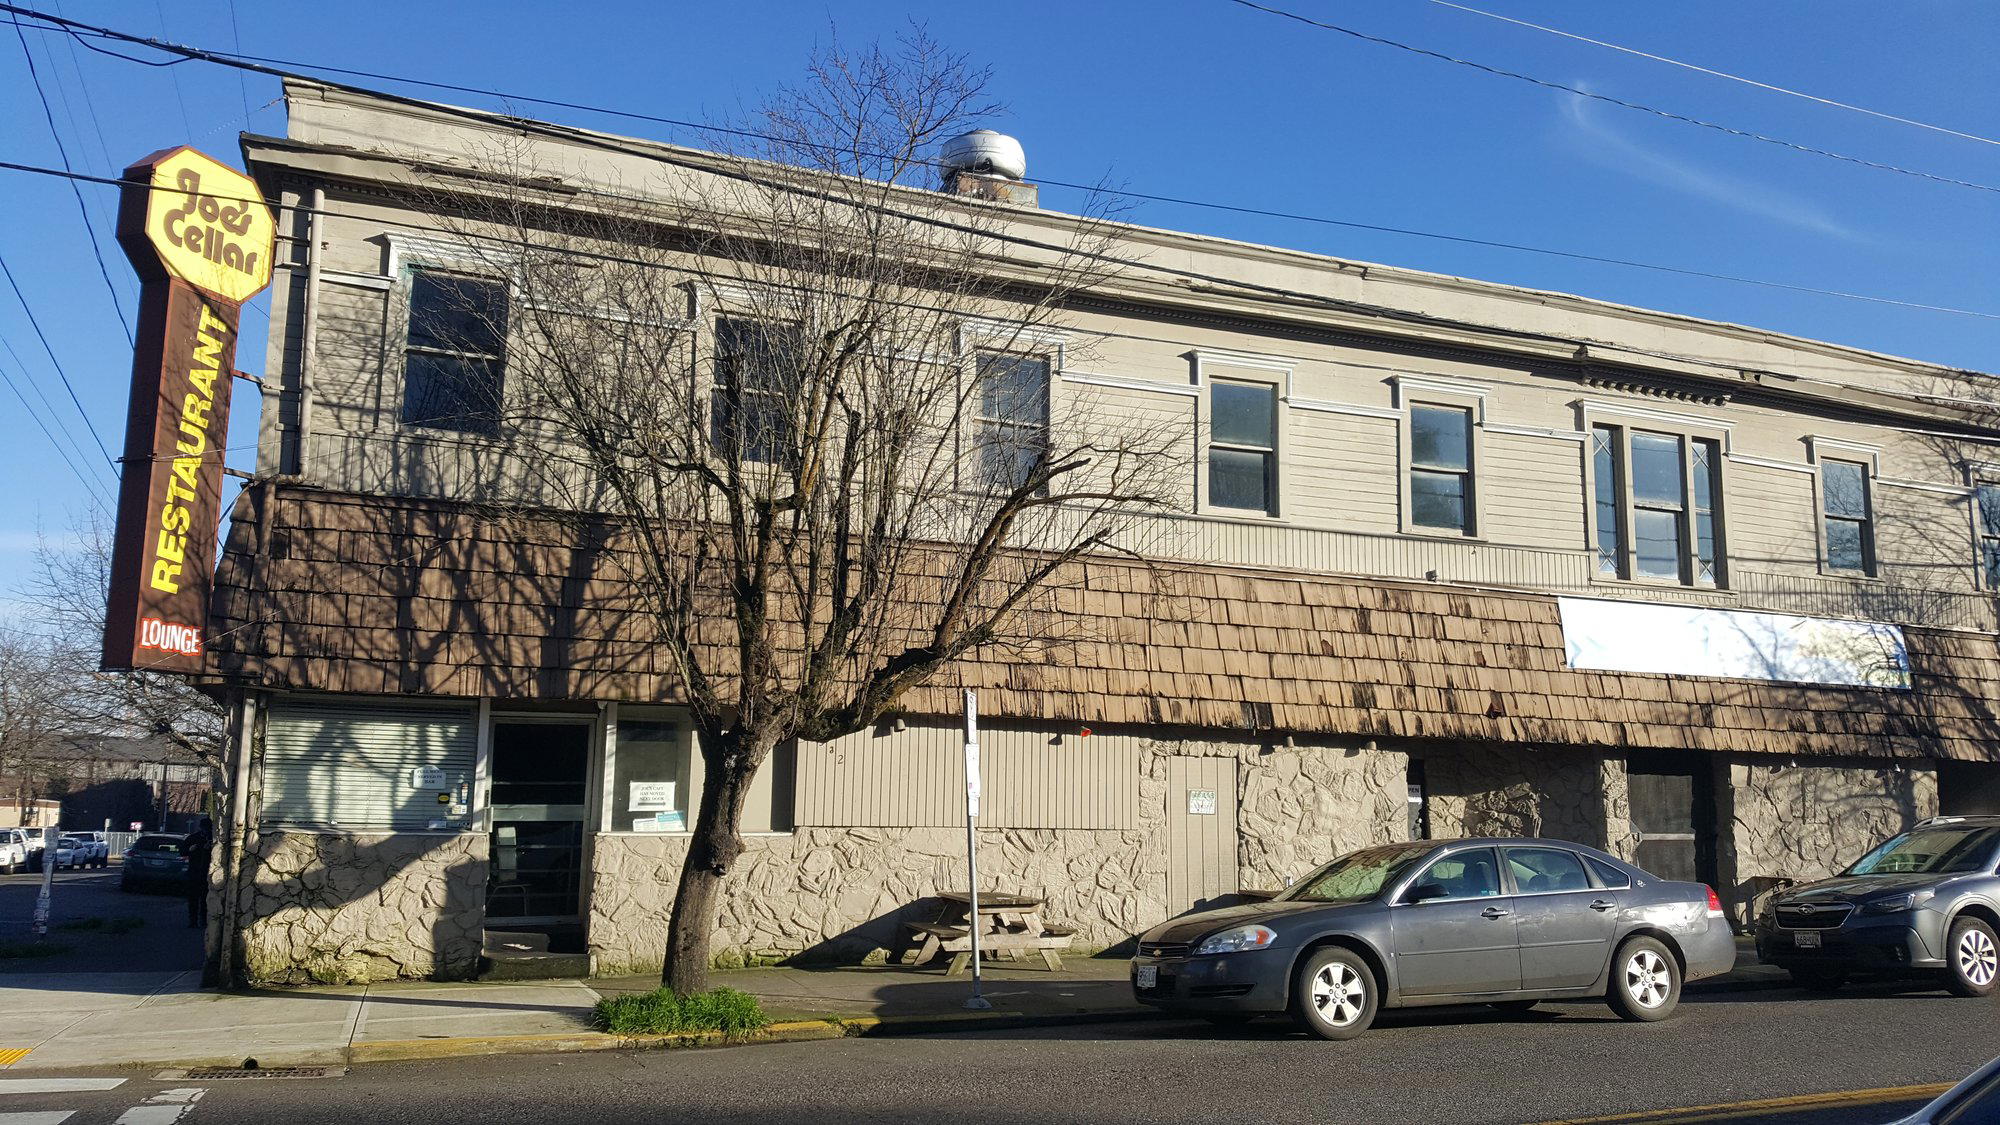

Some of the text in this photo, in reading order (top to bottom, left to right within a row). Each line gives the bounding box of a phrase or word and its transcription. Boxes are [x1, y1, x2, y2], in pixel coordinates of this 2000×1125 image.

[163, 208, 258, 276] Cellar
[150, 304, 228, 595] RESTAURANT
[141, 619, 202, 653] LOUNGE
[837, 754, 844, 765] 2
